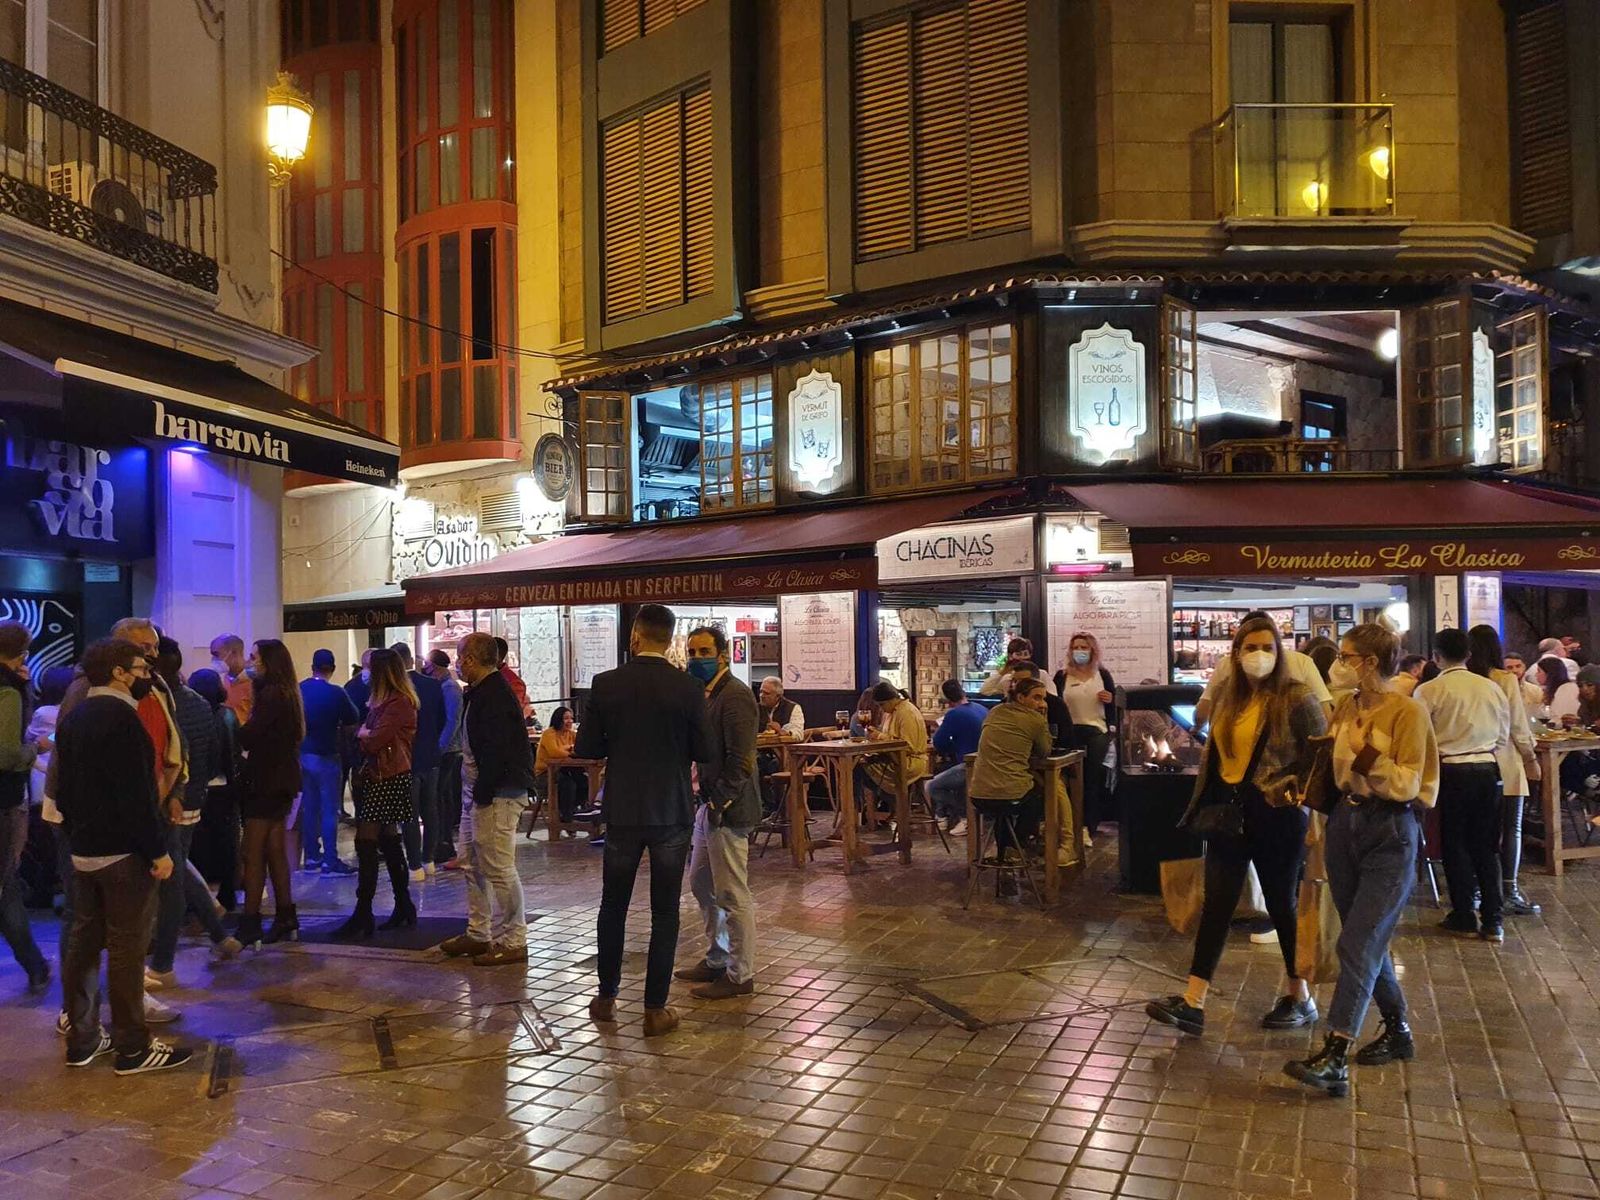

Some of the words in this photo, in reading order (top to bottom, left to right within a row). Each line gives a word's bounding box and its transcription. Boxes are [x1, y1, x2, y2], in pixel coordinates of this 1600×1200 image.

[1092, 364, 1123, 373] VINOS
[1082, 375, 1132, 383] ESCOGIDOS
[802, 401, 828, 412] VERMUT
[152, 400, 291, 463] barsovia
[345, 459, 386, 478] Heineken
[545, 462, 564, 474] BIER
[436, 519, 473, 535] Asador
[896, 533, 995, 562] CHACINAS
[1240, 545, 1377, 569] Vermuteria
[1379, 543, 1427, 569] La
[1430, 543, 1526, 568] Clasica
[764, 570, 781, 588] La
[786, 568, 824, 587] Clasica
[505, 584, 556, 603] CERVEZA
[559, 580, 621, 600] ENFRIADA
[625, 578, 641, 597] EN
[645, 573, 724, 594] SERPENTIN
[326, 611, 359, 626] Asador
[365, 608, 399, 626] Ovidio
